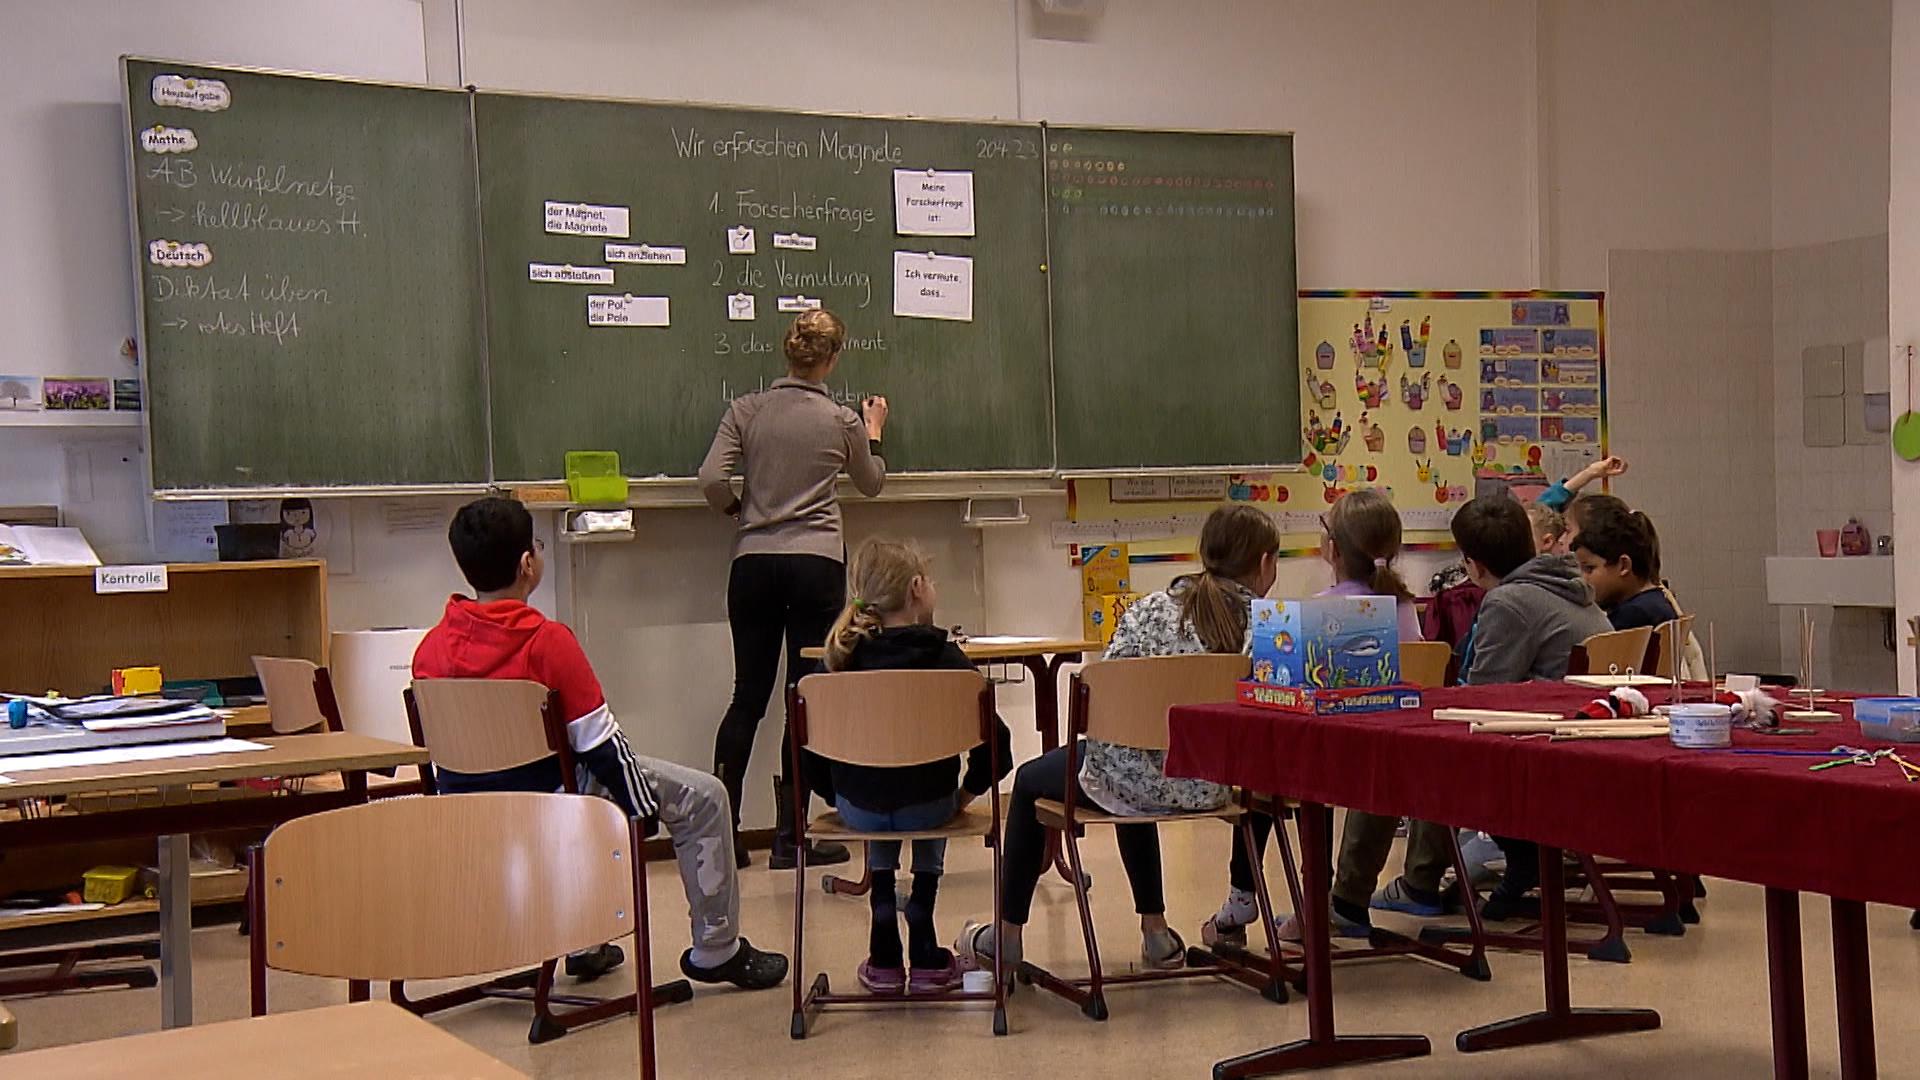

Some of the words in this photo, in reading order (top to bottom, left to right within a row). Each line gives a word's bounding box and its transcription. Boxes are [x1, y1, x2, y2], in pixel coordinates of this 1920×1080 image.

[148, 134, 186, 144] Mathe
[671, 127, 704, 158] Wir
[712, 127, 808, 162] erforschen
[819, 127, 903, 175] Magnete
[146, 157, 197, 188] AB
[921, 183, 946, 192] Meine
[906, 198, 964, 210] Forscherfrage
[547, 207, 563, 216] der
[566, 208, 606, 220] Magnet,
[735, 188, 876, 233] Forscherfrage
[547, 220, 562, 230] die
[564, 222, 608, 233] Magnete
[156, 249, 205, 260] Deutsch
[608, 250, 625, 259] sich
[628, 251, 672, 262] anziehen
[532, 268, 552, 279] sich
[905, 269, 921, 280] Ich
[736, 258, 767, 288] die
[774, 254, 872, 309] Vermutung
[152, 273, 250, 302] Diktat
[260, 273, 331, 304] üben
[590, 300, 605, 309] der
[591, 313, 605, 322] die
[608, 313, 629, 323] Pole
[250, 310, 300, 346] Heft
[741, 332, 774, 355] das
[102, 572, 161, 584] Kontrolle
